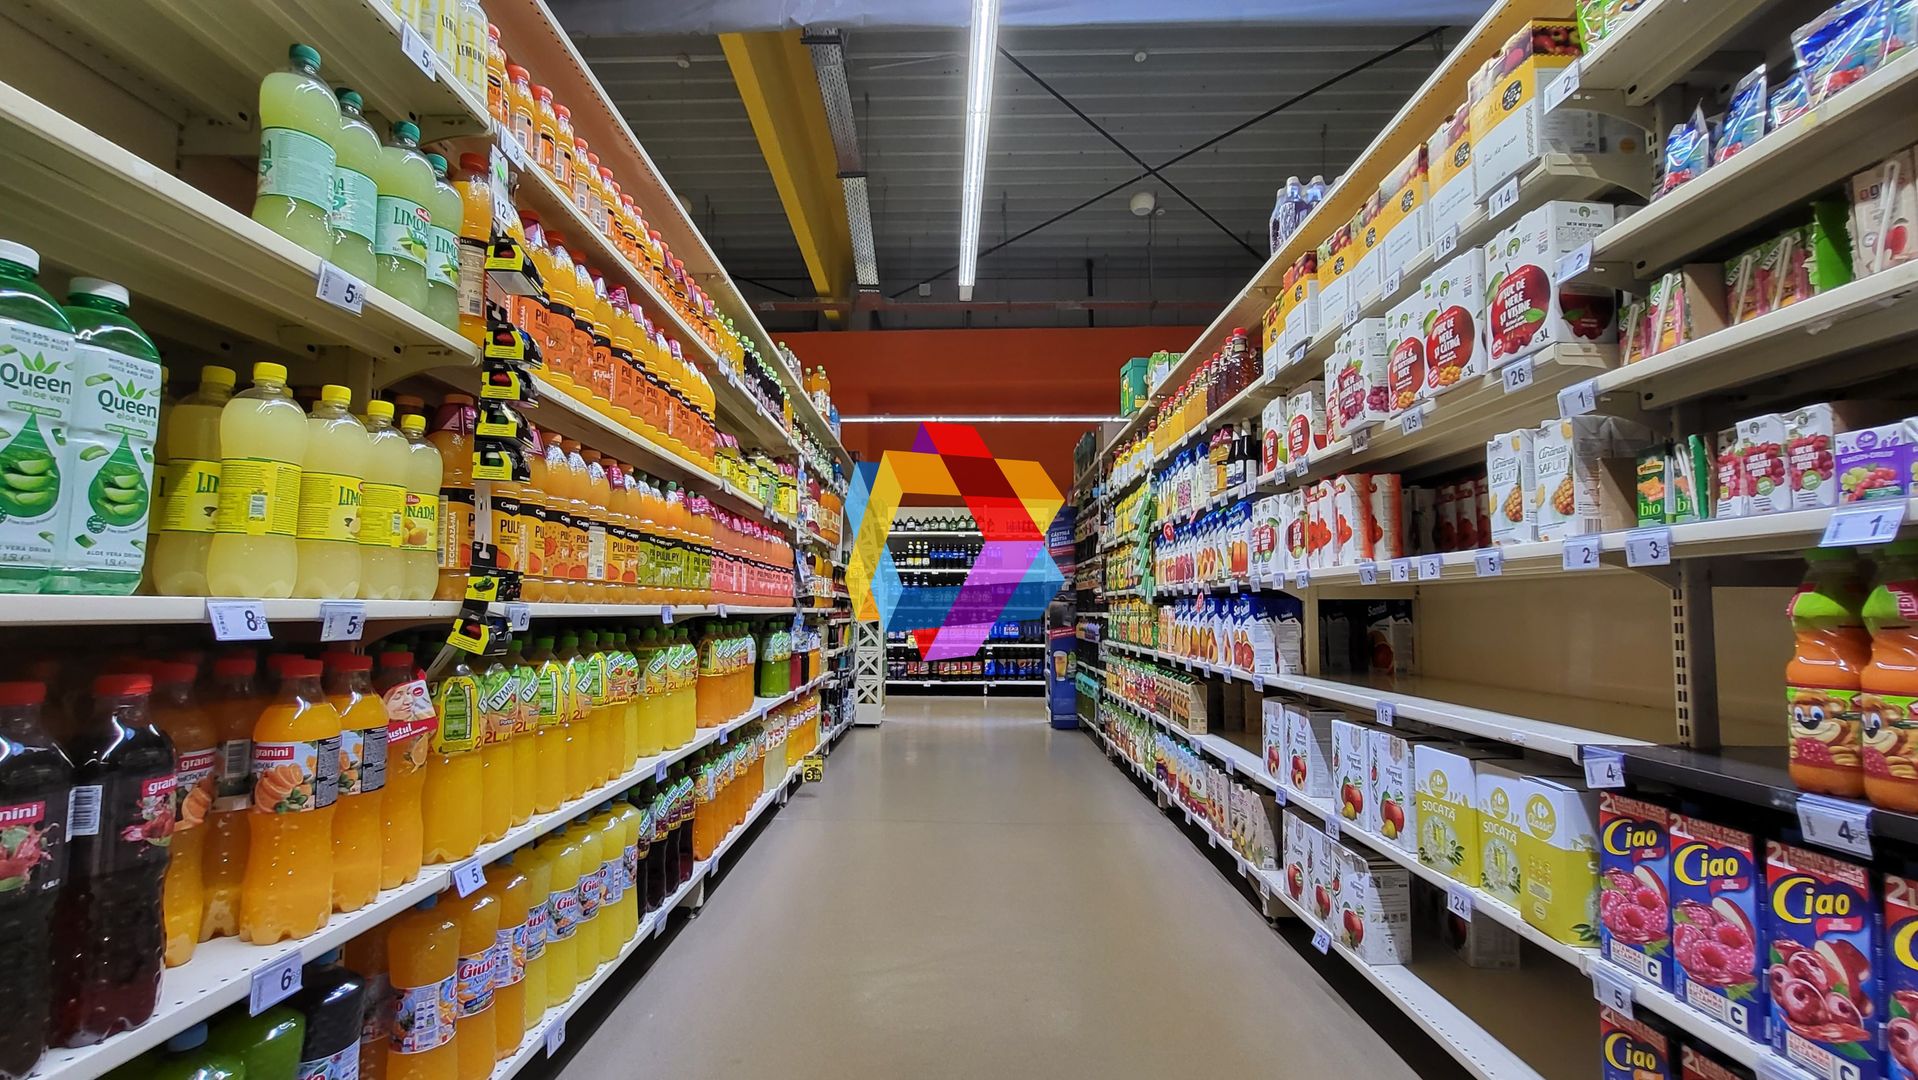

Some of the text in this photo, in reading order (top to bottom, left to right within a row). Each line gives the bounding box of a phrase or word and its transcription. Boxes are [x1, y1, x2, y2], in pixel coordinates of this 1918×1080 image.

[1563, 75, 1572, 95] 2
[1498, 189, 1511, 209] 14
[1440, 236, 1451, 253] 18
[1575, 253, 1584, 270] 2
[344, 283, 354, 303] 5
[1385, 279, 1395, 294] 18
[0, 362, 72, 396] Queen
[1510, 368, 1525, 386] 26
[21, 388, 48, 401] aloe
[1578, 392, 1586, 408] 1
[97, 389, 158, 419] Queen
[116, 413, 137, 423] aloe
[1406, 415, 1418, 430] 25
[500, 502, 518, 511] Cappy
[1640, 502, 1661, 516] bio
[1870, 514, 1883, 537] 1
[1582, 547, 1592, 564] 2
[1649, 541, 1659, 559] 3
[1400, 565, 1406, 579] 5
[1429, 562, 1436, 576] 3
[1489, 557, 1496, 572] 5
[244, 610, 258, 632] 8
[346, 615, 358, 635] 5
[520, 612, 527, 627] 6
[1380, 707, 1389, 722] 16
[514, 721, 530, 734] 2L
[484, 731, 501, 744] 2L
[1606, 763, 1615, 782] 4
[1422, 800, 1457, 821] SOCATĂ
[1482, 821, 1518, 847] SOCATĂ
[1602, 818, 1658, 856] Ciao
[1838, 820, 1855, 845] 4
[1673, 844, 1739, 886] Ciao
[471, 868, 480, 884] 5
[1454, 897, 1465, 913] 24
[1772, 876, 1850, 924] Ciao
[1647, 961, 1658, 978] C
[281, 967, 292, 991] 6
[1615, 990, 1624, 1010] 5
[1730, 1006, 1742, 1025] C
[1604, 1032, 1657, 1071] Ciao
